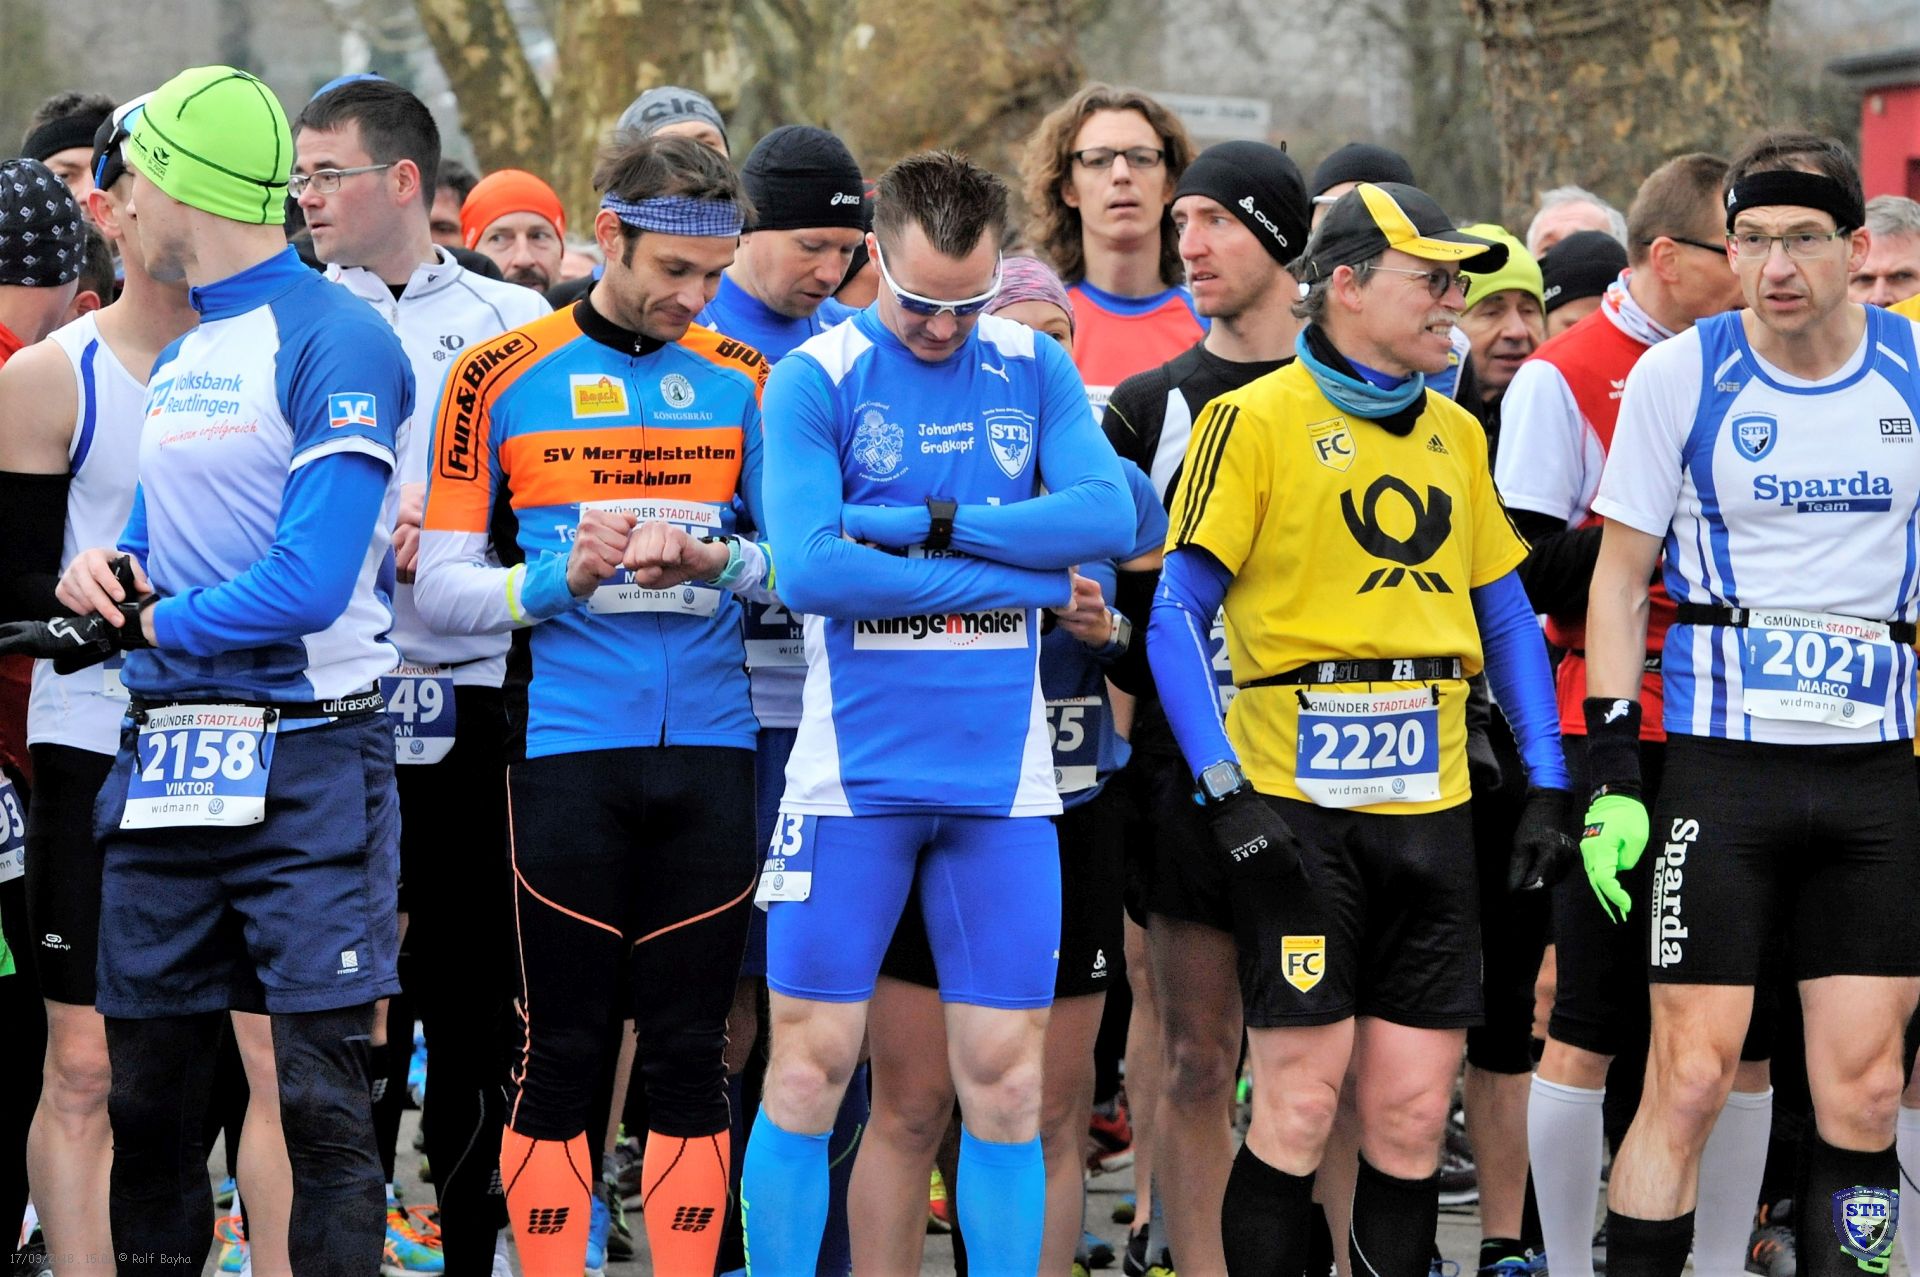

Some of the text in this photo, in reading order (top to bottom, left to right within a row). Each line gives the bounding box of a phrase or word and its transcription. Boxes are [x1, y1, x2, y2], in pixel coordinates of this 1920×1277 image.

[842, 194, 860, 205] asics
[1254, 209, 1288, 248] odlo
[175, 371, 243, 393] Volksbank
[165, 393, 240, 417] Reutlingen
[653, 410, 713, 420] KÖNIGSBRÄU
[918, 421, 974, 436] Johannes
[990, 423, 1029, 443] STR
[1741, 426, 1769, 436] STR
[1881, 420, 1911, 434] DEE
[920, 436, 975, 454] Großkopf
[1316, 433, 1351, 461] FC
[544, 446, 736, 463] SV Mergelstetten
[590, 469, 692, 487] Triathlon
[1753, 471, 1894, 507] Sparda
[659, 507, 712, 523] STADTLAUF
[1805, 502, 1850, 512] Team
[618, 590, 677, 600] widmann
[1764, 615, 1882, 641] GMÜNDER STADTLAUF
[1762, 630, 1875, 688] 2021
[1797, 679, 1849, 698] MARCO
[1310, 697, 1428, 713] GMÜNDER STADTLAUF
[1780, 698, 1837, 712] widmann
[150, 713, 264, 729] GMÜNDER STADTLAUF
[1310, 719, 1425, 771] 2220
[141, 731, 257, 782] 2158
[165, 782, 215, 795] VIKTOR
[1328, 785, 1384, 795] widmann
[151, 802, 199, 814] widmann
[1232, 839, 1268, 862] GORE
[1652, 866, 1663, 918] Team
[1660, 818, 1700, 969] Sparda
[1287, 952, 1320, 976] FC
[527, 1224, 564, 1235] cep
[671, 1222, 706, 1233] cep
